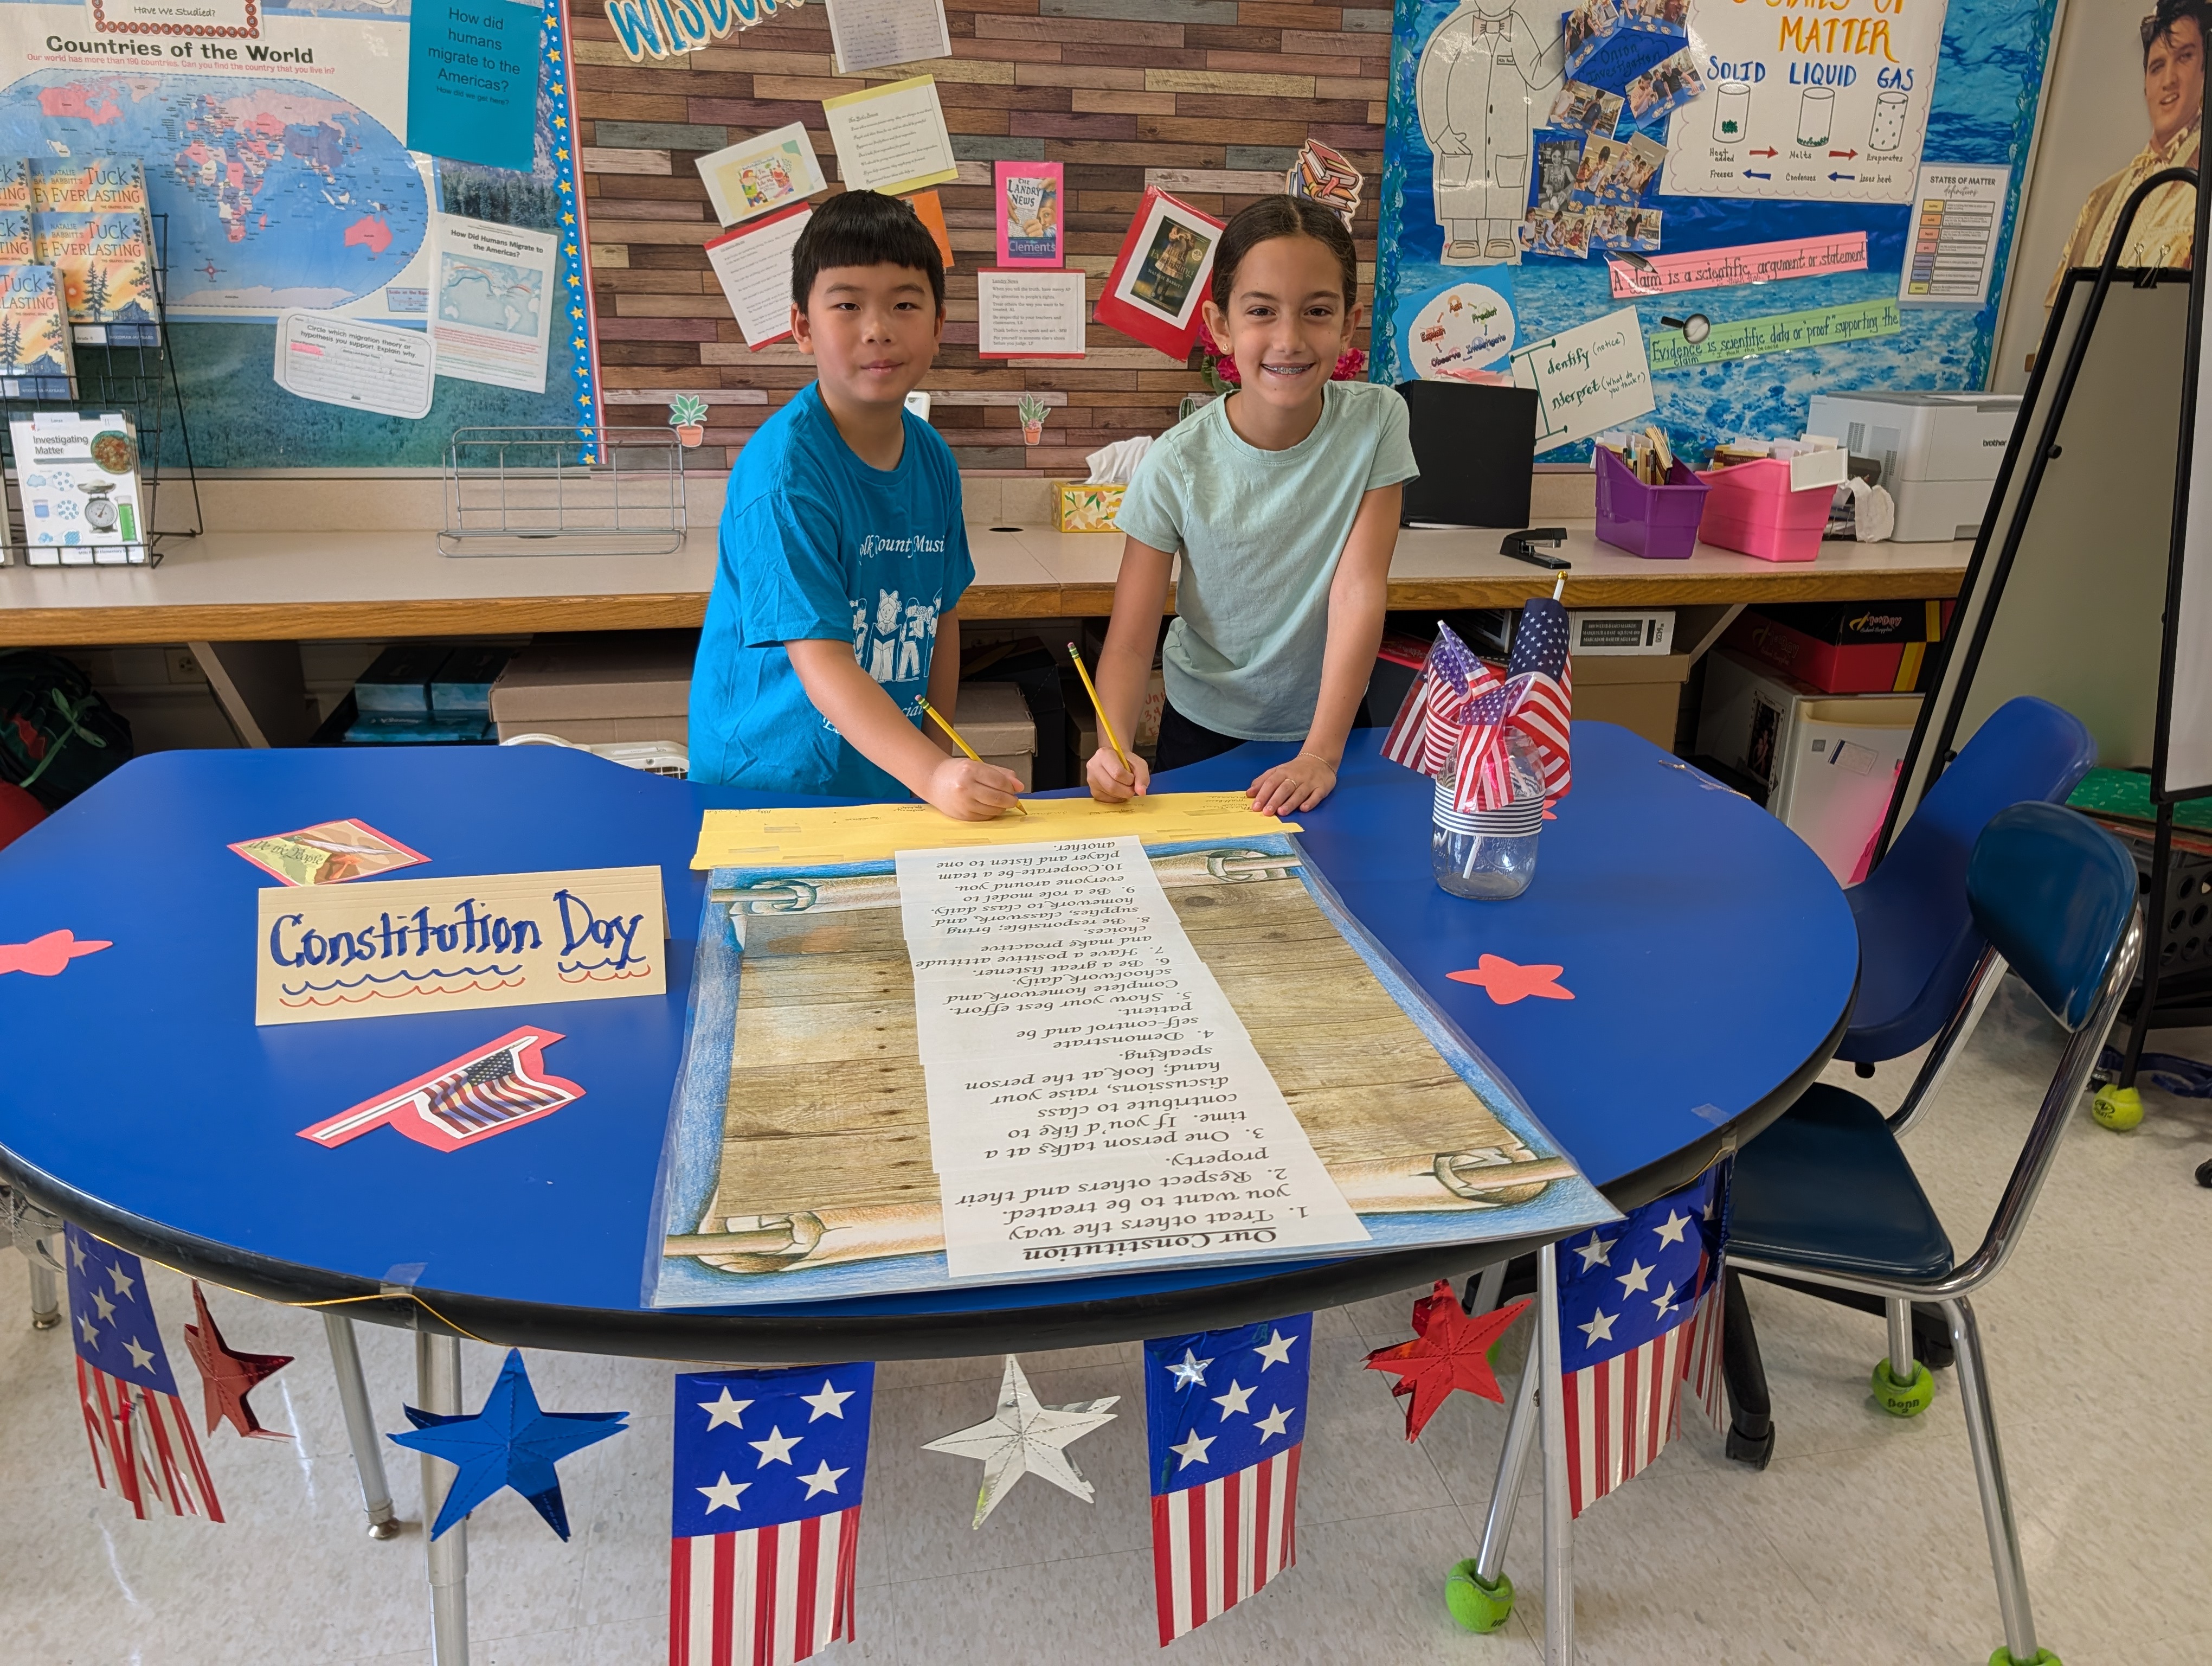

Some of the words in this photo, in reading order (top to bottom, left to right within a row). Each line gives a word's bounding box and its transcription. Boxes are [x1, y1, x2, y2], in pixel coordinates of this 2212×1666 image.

[134, 6, 157, 15] Have
[175, 8, 216, 17] Studied?
[449, 7, 479, 24] How
[484, 16, 504, 30] did
[449, 29, 502, 50] humans
[1779, 16, 1899, 63] MATTER
[46, 36, 163, 56] Countries
[170, 41, 193, 57] of
[200, 42, 238, 60] the
[246, 46, 314, 64] World
[1601, 43, 1637, 65] Onion
[141, 59, 180, 67] countries.
[428, 48, 478, 66] migrate
[483, 57, 495, 69] to
[500, 61, 520, 74] the
[1587, 52, 1660, 84] Investigation
[438, 68, 509, 92] Americas?
[1707, 55, 1765, 84] SOLID
[1790, 62, 1856, 87] LIQUID
[1877, 67, 1914, 91] GAS
[437, 86, 452, 94] How
[490, 97, 509, 105] here?
[1709, 148, 1728, 157] Heat
[1789, 151, 1811, 159] Melts
[1867, 153, 1903, 164] Evaporates
[1715, 153, 1734, 162] added
[1710, 169, 1733, 178] Freezes
[1785, 173, 1816, 182] Condenses
[1877, 174, 1892, 183] heat
[52, 188, 140, 203] EVERLASTING
[1007, 180, 1041, 196] LANDRY
[1012, 195, 1034, 207] NEWS
[451, 229, 466, 238] How
[481, 235, 507, 246] Humans
[510, 241, 534, 251] Migrate
[1008, 241, 1056, 252] Clements
[52, 241, 141, 257] EVERLASTING
[486, 247, 520, 258] Americas?
[1613, 271, 1623, 291] A
[1669, 270, 1680, 285] is
[1684, 272, 1692, 282] a
[1696, 257, 1751, 280] scientific
[1757, 249, 1805, 280] argument
[1808, 255, 1817, 267] or
[1819, 242, 1865, 265] statement
[0, 297, 54, 310] LASTING
[1449, 302, 1463, 313] Ask
[1472, 307, 1497, 323] Predict
[329, 329, 346, 337] which
[349, 334, 380, 343] migration
[382, 339, 402, 349] theory
[1420, 328, 1445, 342] Explain
[1652, 339, 1702, 362] Evidence
[1708, 338, 1716, 352] is
[1721, 324, 1765, 350] scientific
[1770, 324, 1789, 343] data
[1793, 328, 1802, 341] or
[1834, 312, 1878, 338] supporting
[1882, 306, 1898, 324] the
[301, 331, 333, 342] hypothesis
[350, 342, 374, 351] support.
[377, 346, 401, 355] Explain
[403, 350, 416, 358] why.
[1593, 332, 1625, 356] (notice)
[1431, 351, 1461, 367] Observe
[1674, 355, 1699, 367] claim
[1626, 370, 1632, 380] do
[1609, 387, 1619, 399] you
[33, 435, 88, 445] Investigating
[35, 446, 63, 454] Matter
[914, 535, 944, 553] Musi
[272, 844, 288, 855] the
[283, 847, 323, 864] People
[938, 872, 977, 880] team
[271, 898, 543, 967] Constitution
[554, 889, 645, 970] Day
[1103, 1131, 1177, 1150] person
[1185, 1131, 1229, 1142] One
[1246, 1128, 1264, 1138] 3.
[985, 1150, 998, 1159] a
[1007, 1147, 1031, 1157] at
[1038, 1143, 1096, 1157] talks
[1166, 1146, 1269, 1167] property.
[1159, 1171, 1251, 1188] Respect
[1266, 1168, 1287, 1180] 2.
[1024, 1184, 1070, 1204] and
[1079, 1180, 1150, 1192] others
[955, 1189, 1014, 1206] their
[1122, 1213, 1196, 1230] others
[1206, 1209, 1274, 1225] Treat
[1290, 1207, 1309, 1220] 1.
[1008, 1226, 1064, 1240] way
[1073, 1221, 1113, 1236] the
[1219, 1230, 1277, 1242] Our
[1023, 1234, 1210, 1261] Constitution
